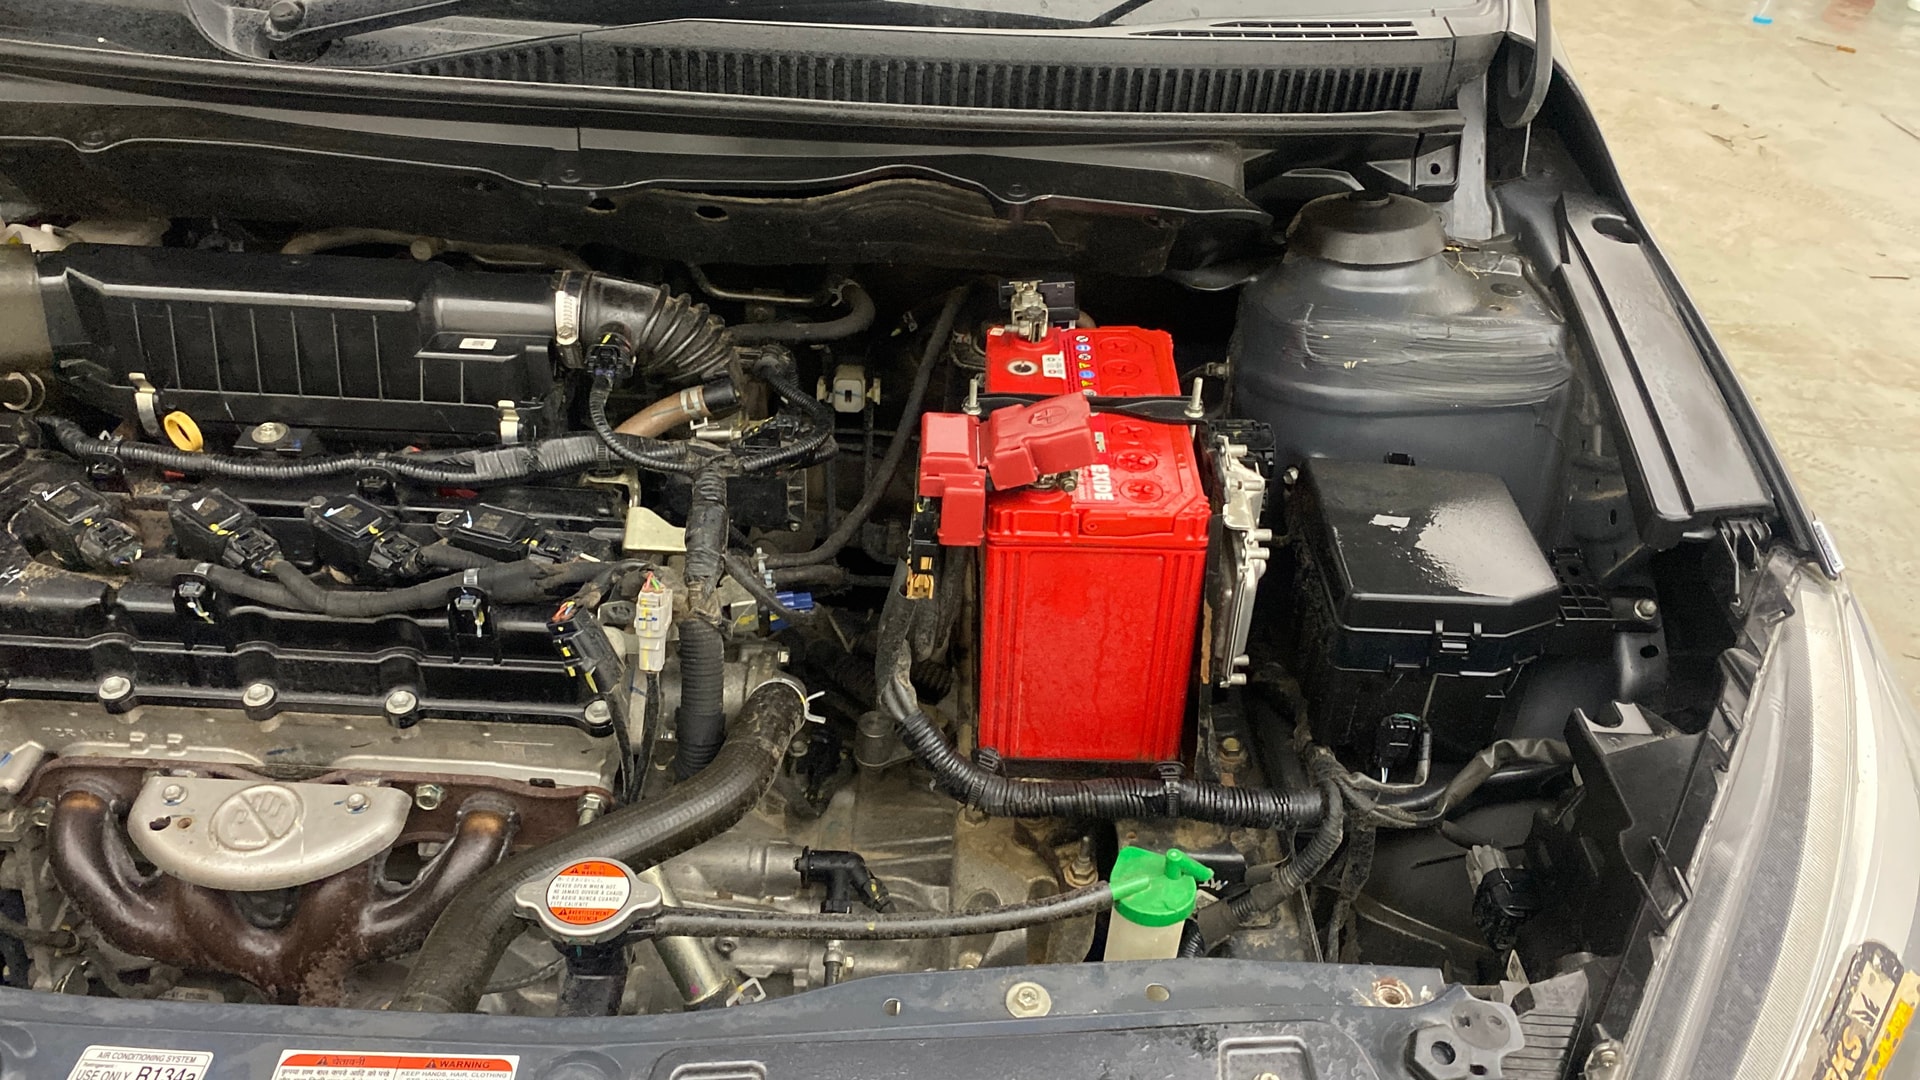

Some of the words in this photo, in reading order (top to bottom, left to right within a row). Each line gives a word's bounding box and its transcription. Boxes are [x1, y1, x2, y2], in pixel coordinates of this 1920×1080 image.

[1090, 464, 1114, 500] EXIDE
[97, 1052, 111, 1060] AIR
[111, 1053, 165, 1063] CONDITIONING
[167, 1055, 198, 1063] SYSTEM
[440, 1060, 490, 1069] WARNING
[76, 1069, 101, 1080] USE
[102, 1070, 132, 1080] ONLY
[136, 1066, 197, 1080] R134a
